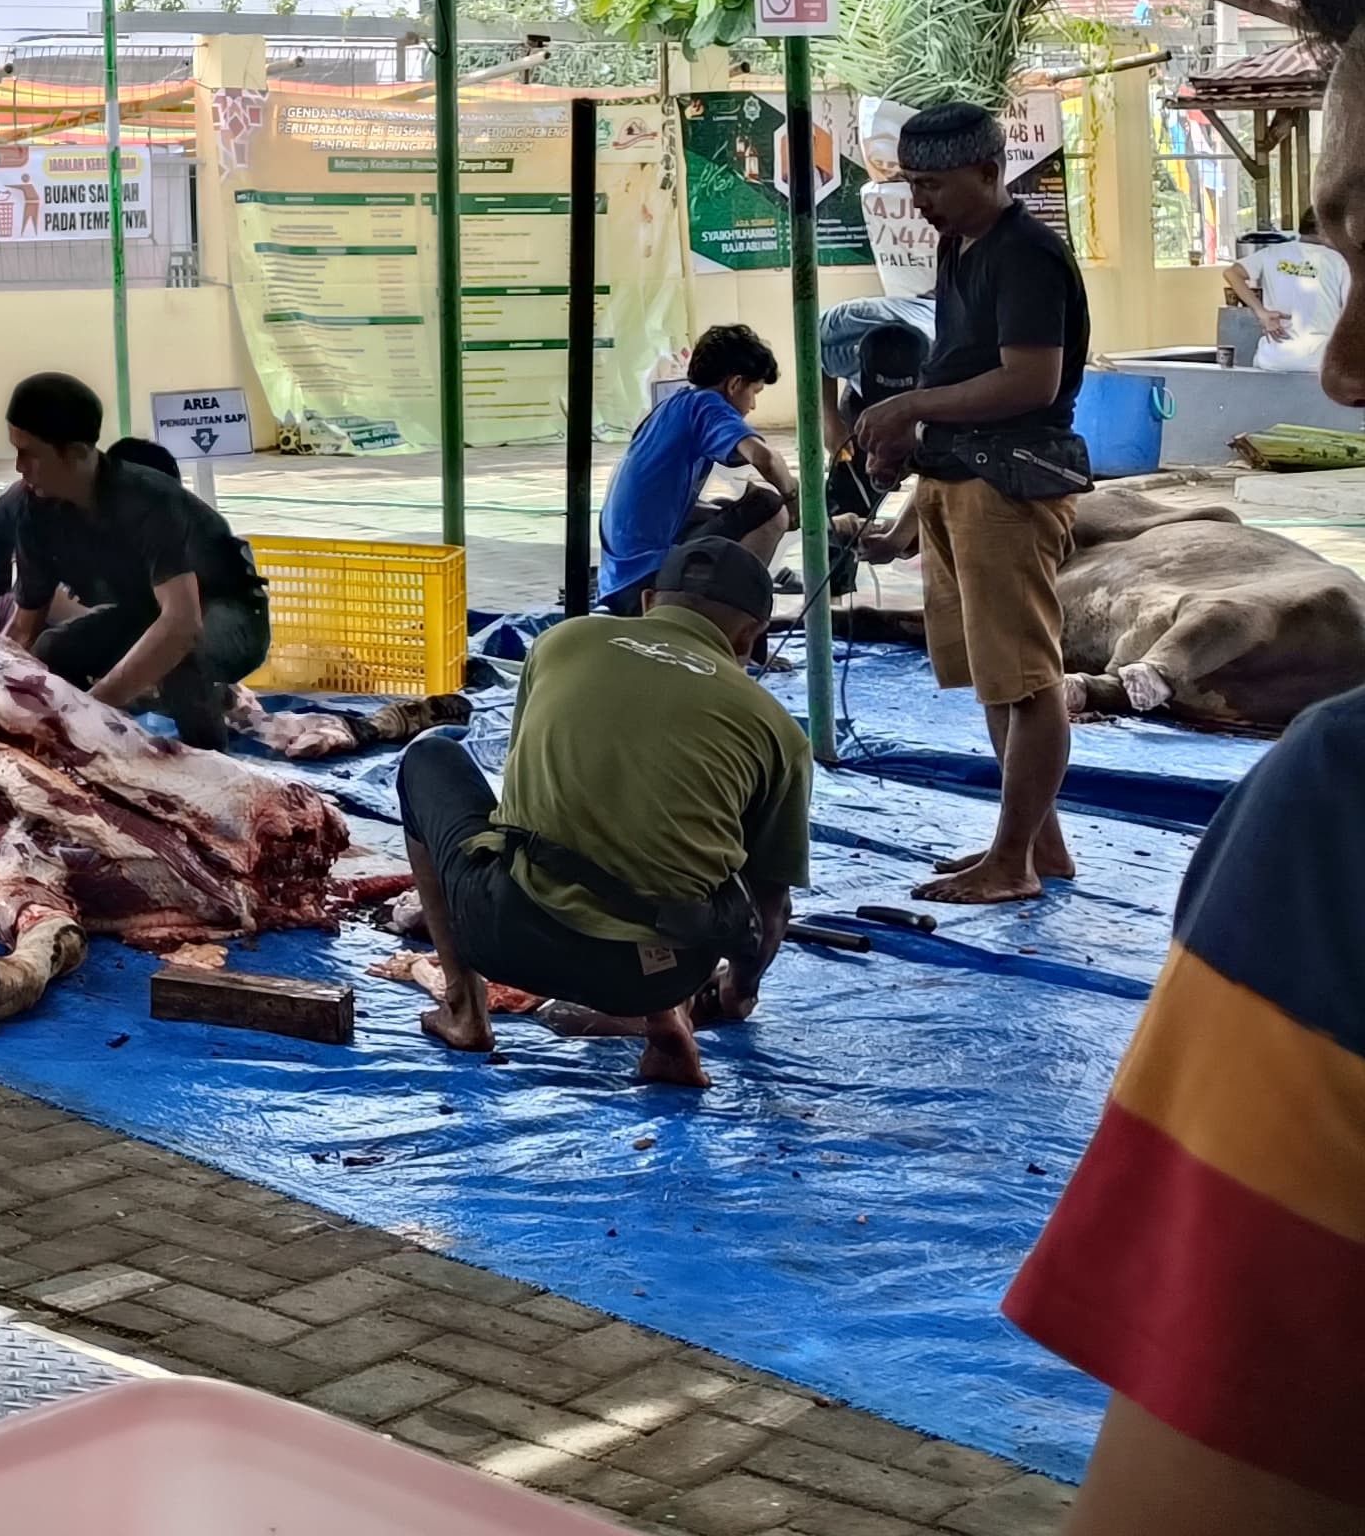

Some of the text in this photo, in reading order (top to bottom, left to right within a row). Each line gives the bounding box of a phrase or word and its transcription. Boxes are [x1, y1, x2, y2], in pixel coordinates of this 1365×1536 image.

[280, 106, 328, 119] AGENDA
[278, 122, 352, 136] PERUMAHAN
[354, 125, 384, 136] BUMI
[387, 126, 422, 137] PUSPA
[479, 127, 525, 138] GEDONG
[524, 127, 570, 139] MENENG
[1034, 124, 1045, 143] H
[312, 138, 358, 151] BANDAR
[362, 140, 419, 152] LAMPUNG
[44, 182, 140, 205] BUANG SAAH
[44, 212, 77, 232] PADA
[183, 397, 220, 411] AREA
[159, 413, 247, 427] PENGULITAN SAPI
[200, 431, 211, 447] 2
